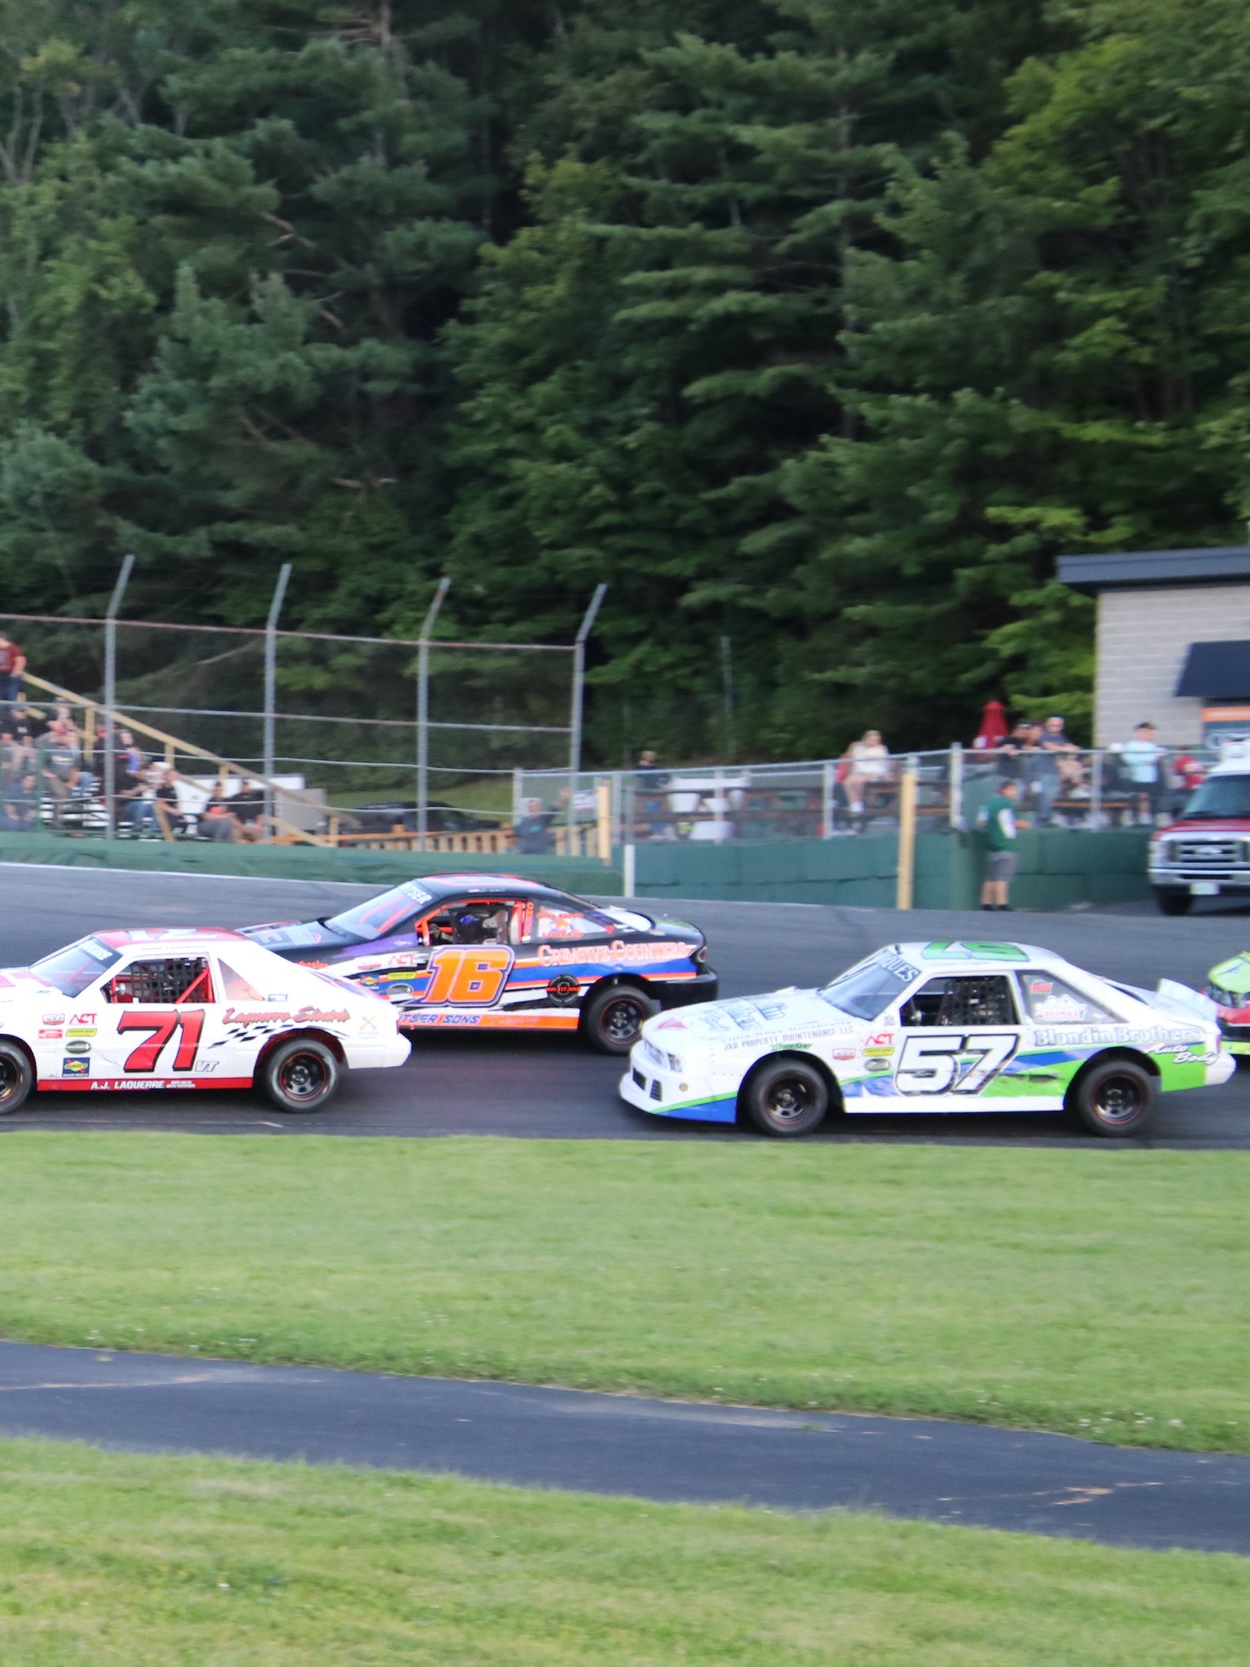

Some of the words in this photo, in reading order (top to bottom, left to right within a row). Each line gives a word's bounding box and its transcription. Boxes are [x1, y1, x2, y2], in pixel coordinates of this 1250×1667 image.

[421, 946, 515, 1008] 16
[69, 1013, 98, 1025] ACT
[441, 1014, 480, 1025] SONS
[116, 1009, 206, 1073] 71
[865, 1034, 895, 1046] ACT
[1034, 1027, 1113, 1047] Blondin
[1114, 1026, 1202, 1044] Brothers
[895, 1033, 1020, 1096] 57
[1173, 1051, 1221, 1065] Body
[90, 1082, 111, 1090] A.J.
